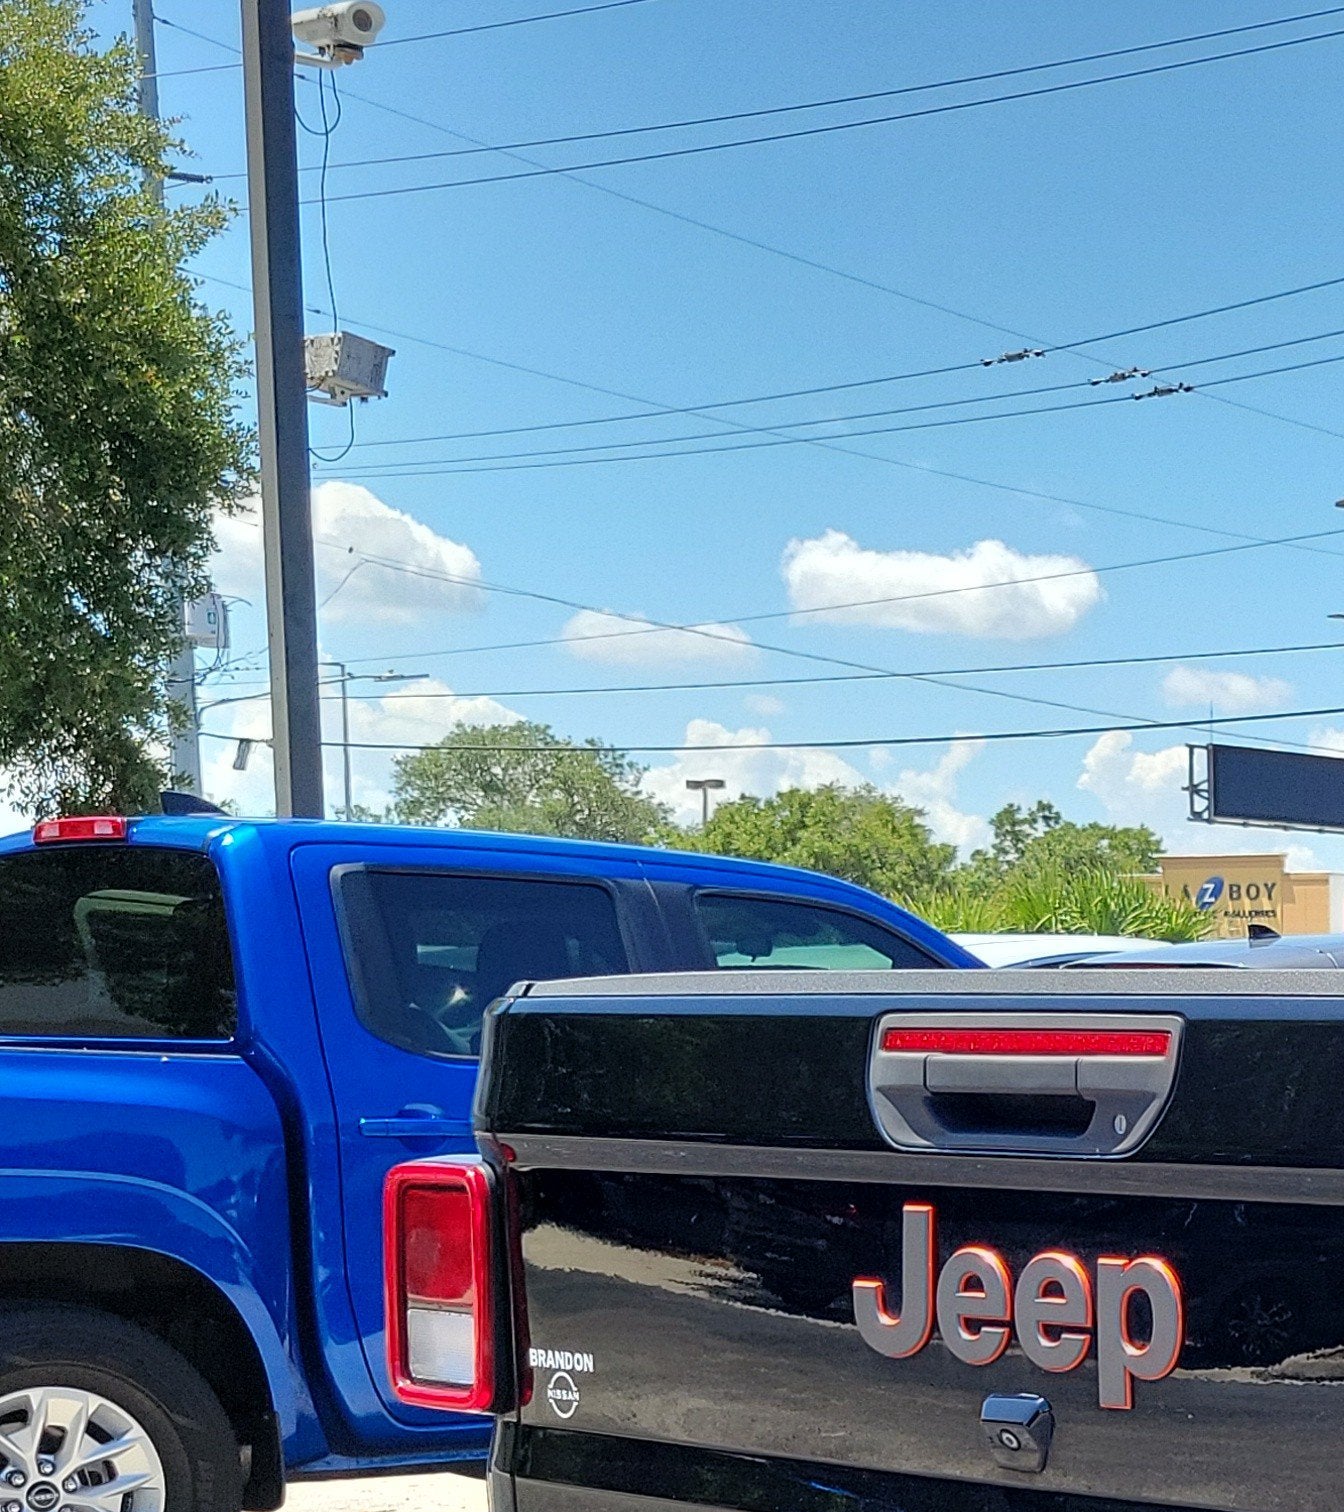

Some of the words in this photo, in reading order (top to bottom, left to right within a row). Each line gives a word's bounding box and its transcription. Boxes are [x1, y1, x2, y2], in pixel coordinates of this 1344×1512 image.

[1202, 883, 1216, 903] Z
[1228, 883, 1276, 901] BOY
[852, 1202, 1185, 1410] Jeep
[529, 1347, 595, 1373] BRANDON
[547, 1388, 580, 1401] NISSAN
